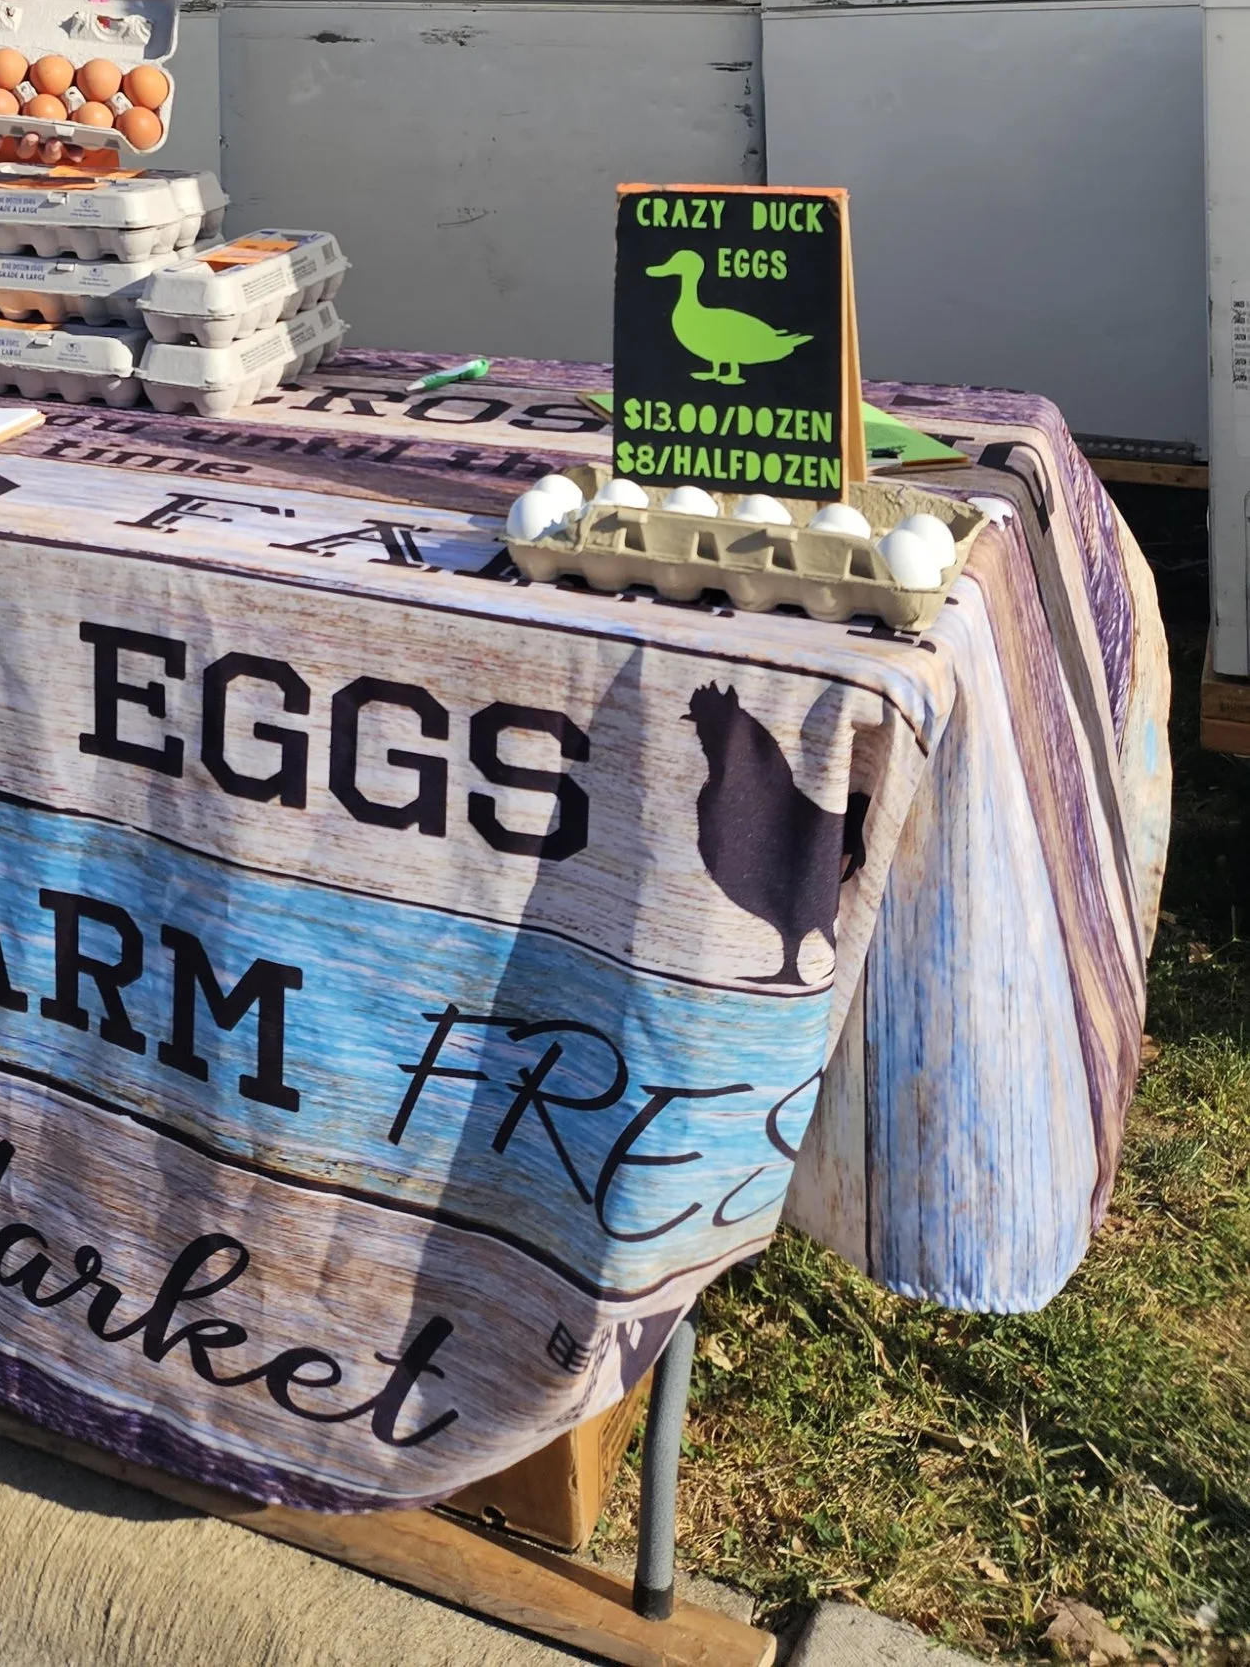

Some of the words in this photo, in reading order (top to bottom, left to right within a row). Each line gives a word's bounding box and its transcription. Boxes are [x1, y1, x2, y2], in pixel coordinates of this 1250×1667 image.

[636, 198, 726, 229] CRAZY
[752, 201, 824, 233] DUCK
[718, 248, 787, 280] EGGS
[623, 398, 833, 443] $13.00/DOZEN
[40, 437, 252, 477] time
[616, 441, 841, 490] $8/HALFDOZEN
[80, 621, 590, 861] EGGS
